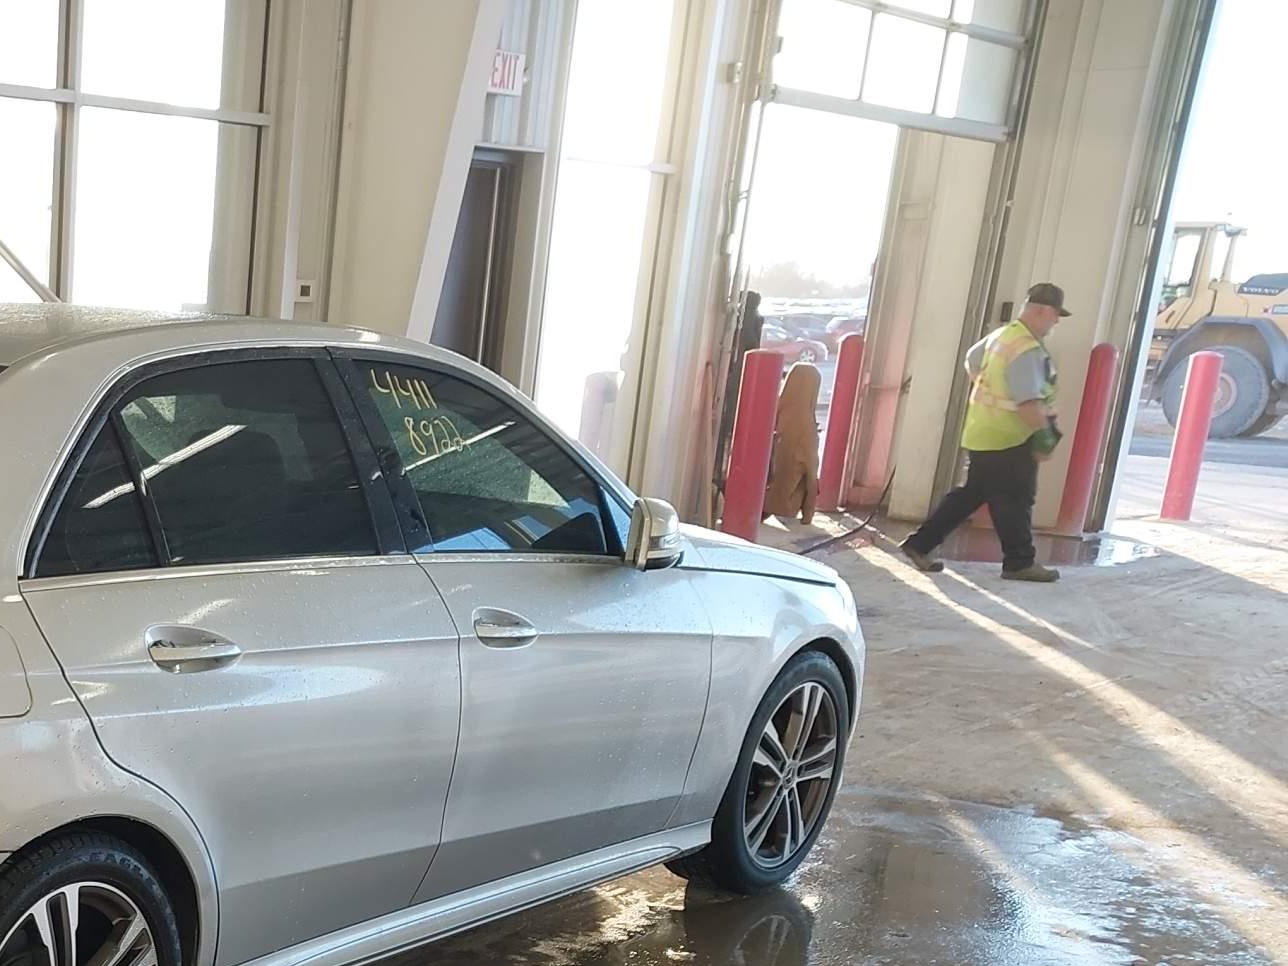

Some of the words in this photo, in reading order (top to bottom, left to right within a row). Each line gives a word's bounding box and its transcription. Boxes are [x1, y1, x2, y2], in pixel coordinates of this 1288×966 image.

[490, 52, 520, 91] EXIT
[370, 368, 438, 410] 4411
[404, 415, 470, 456] 8922
